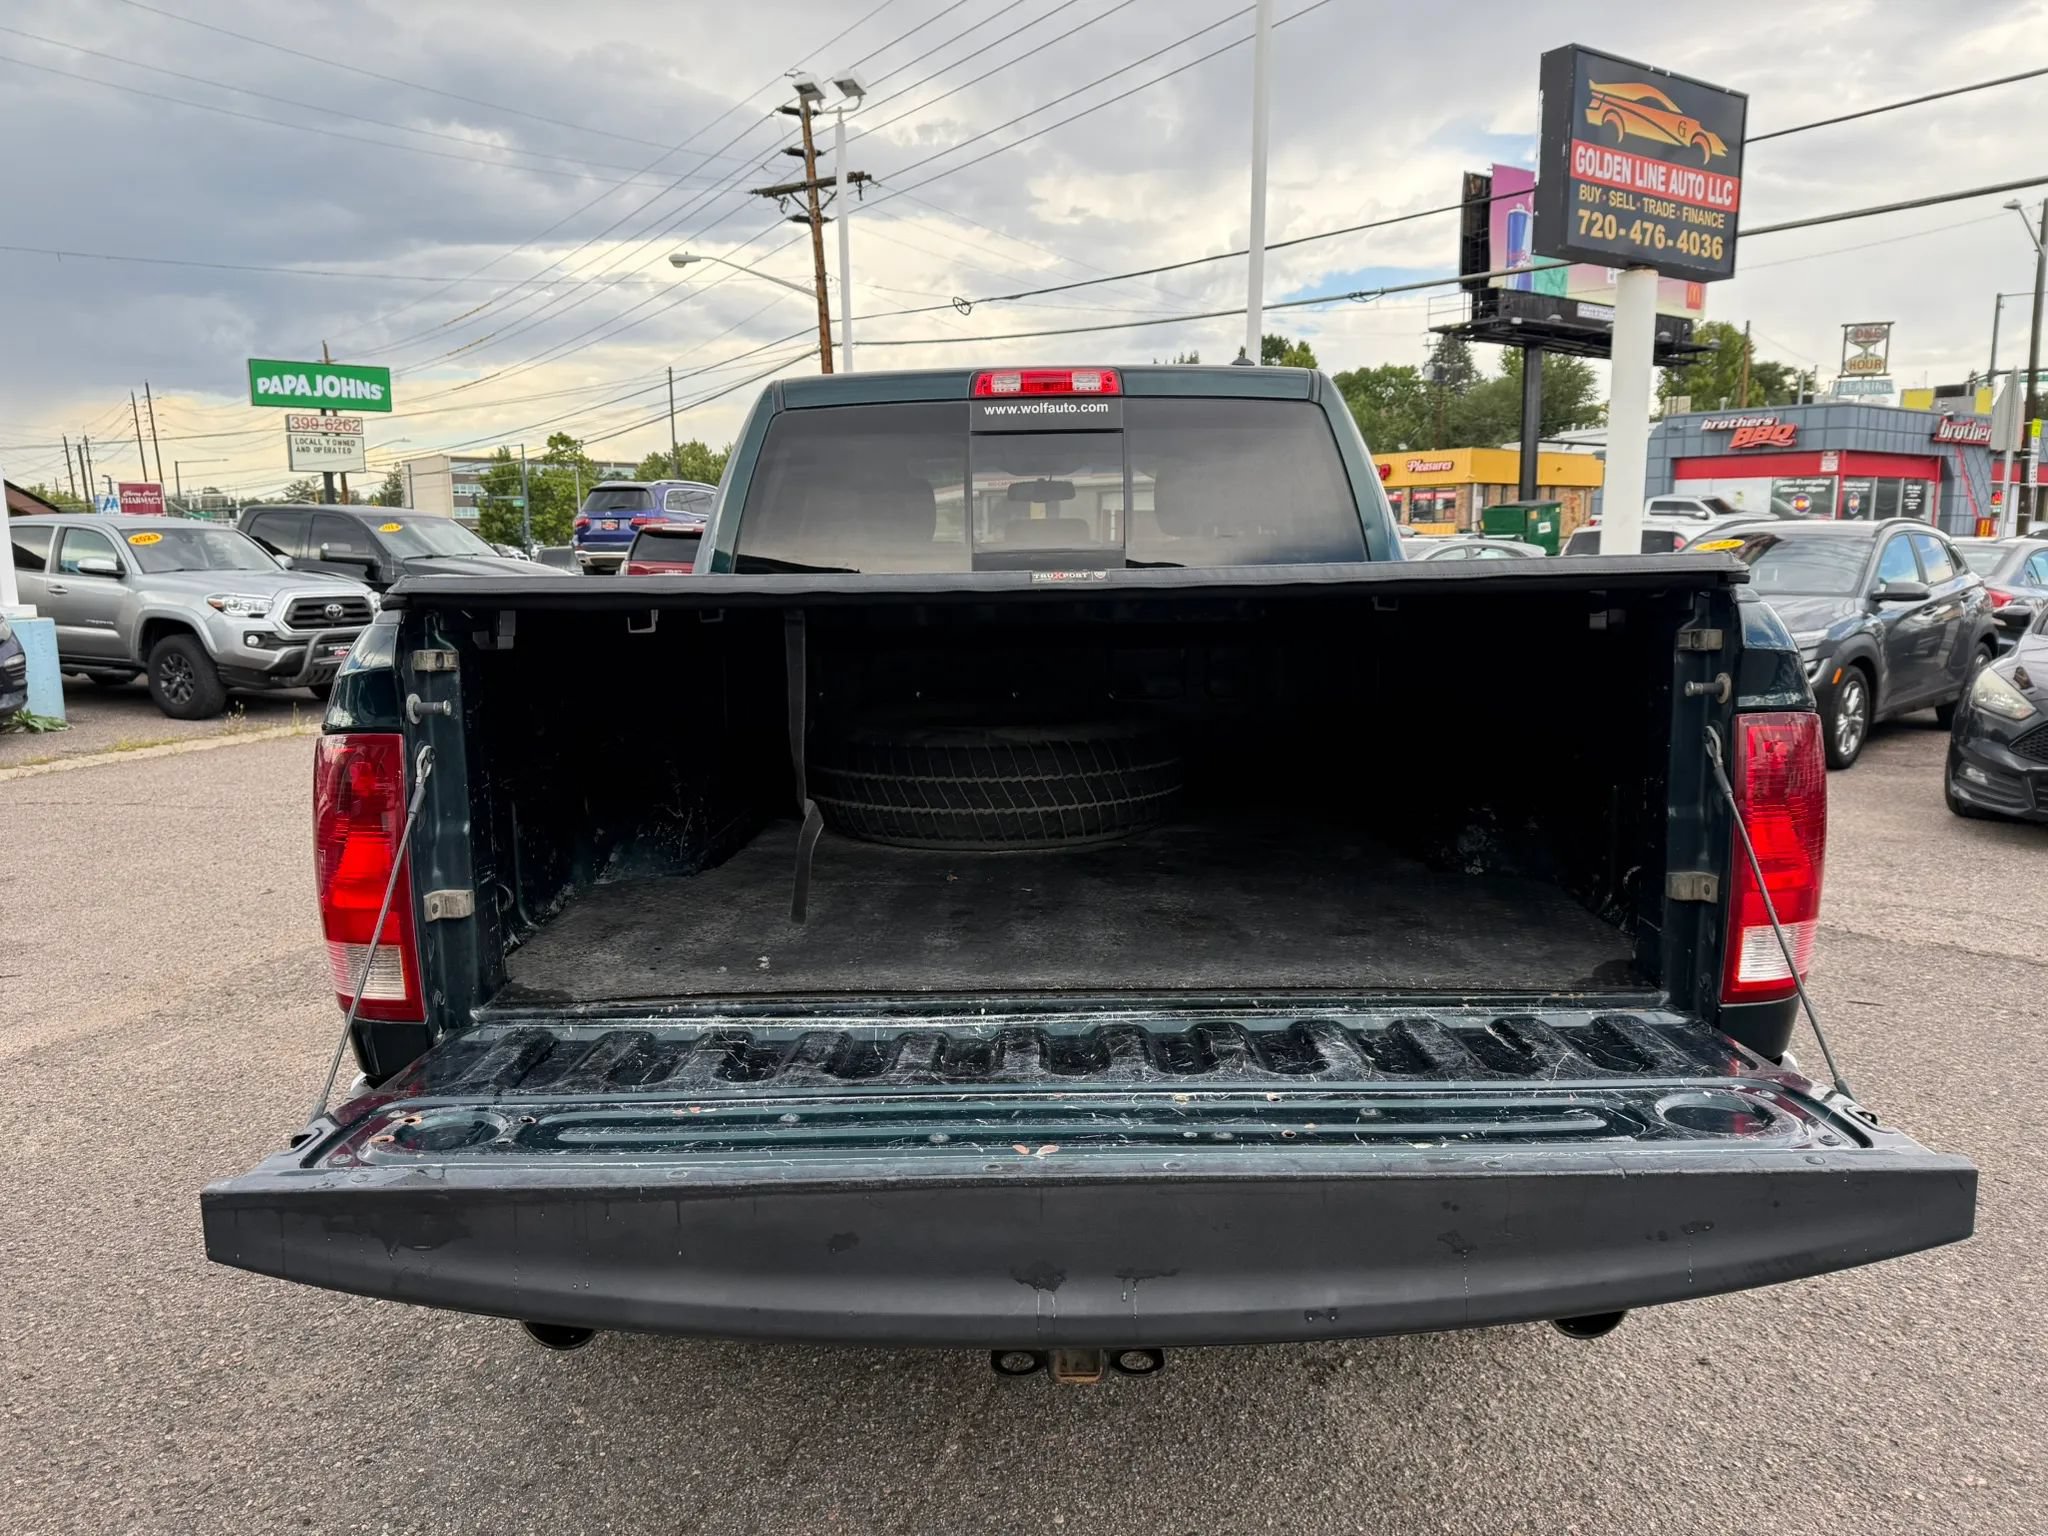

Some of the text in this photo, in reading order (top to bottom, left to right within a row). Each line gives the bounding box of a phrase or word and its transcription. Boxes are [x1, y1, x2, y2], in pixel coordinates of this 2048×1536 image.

[1575, 145, 1733, 206] GOLDEN LINE AUTO LLC
[1579, 184, 1725, 229] BUY SELL TRADE FINANCE
[1856, 327, 1882, 339] ONE
[1849, 359, 1882, 370] HOUR
[256, 374, 384, 400] PAPA JOHNS
[984, 402, 1109, 416] www.wolfauto.com
[291, 416, 361, 432] 399-6262
[1701, 416, 1775, 431] brothers
[1938, 418, 1992, 442] brother
[1731, 424, 1797, 446] BBQ
[331, 438, 356, 447] OWNED
[313, 446, 352, 454] OPERATED
[1407, 459, 1453, 473] Pleasures
[121, 496, 162, 505] PHARMACY
